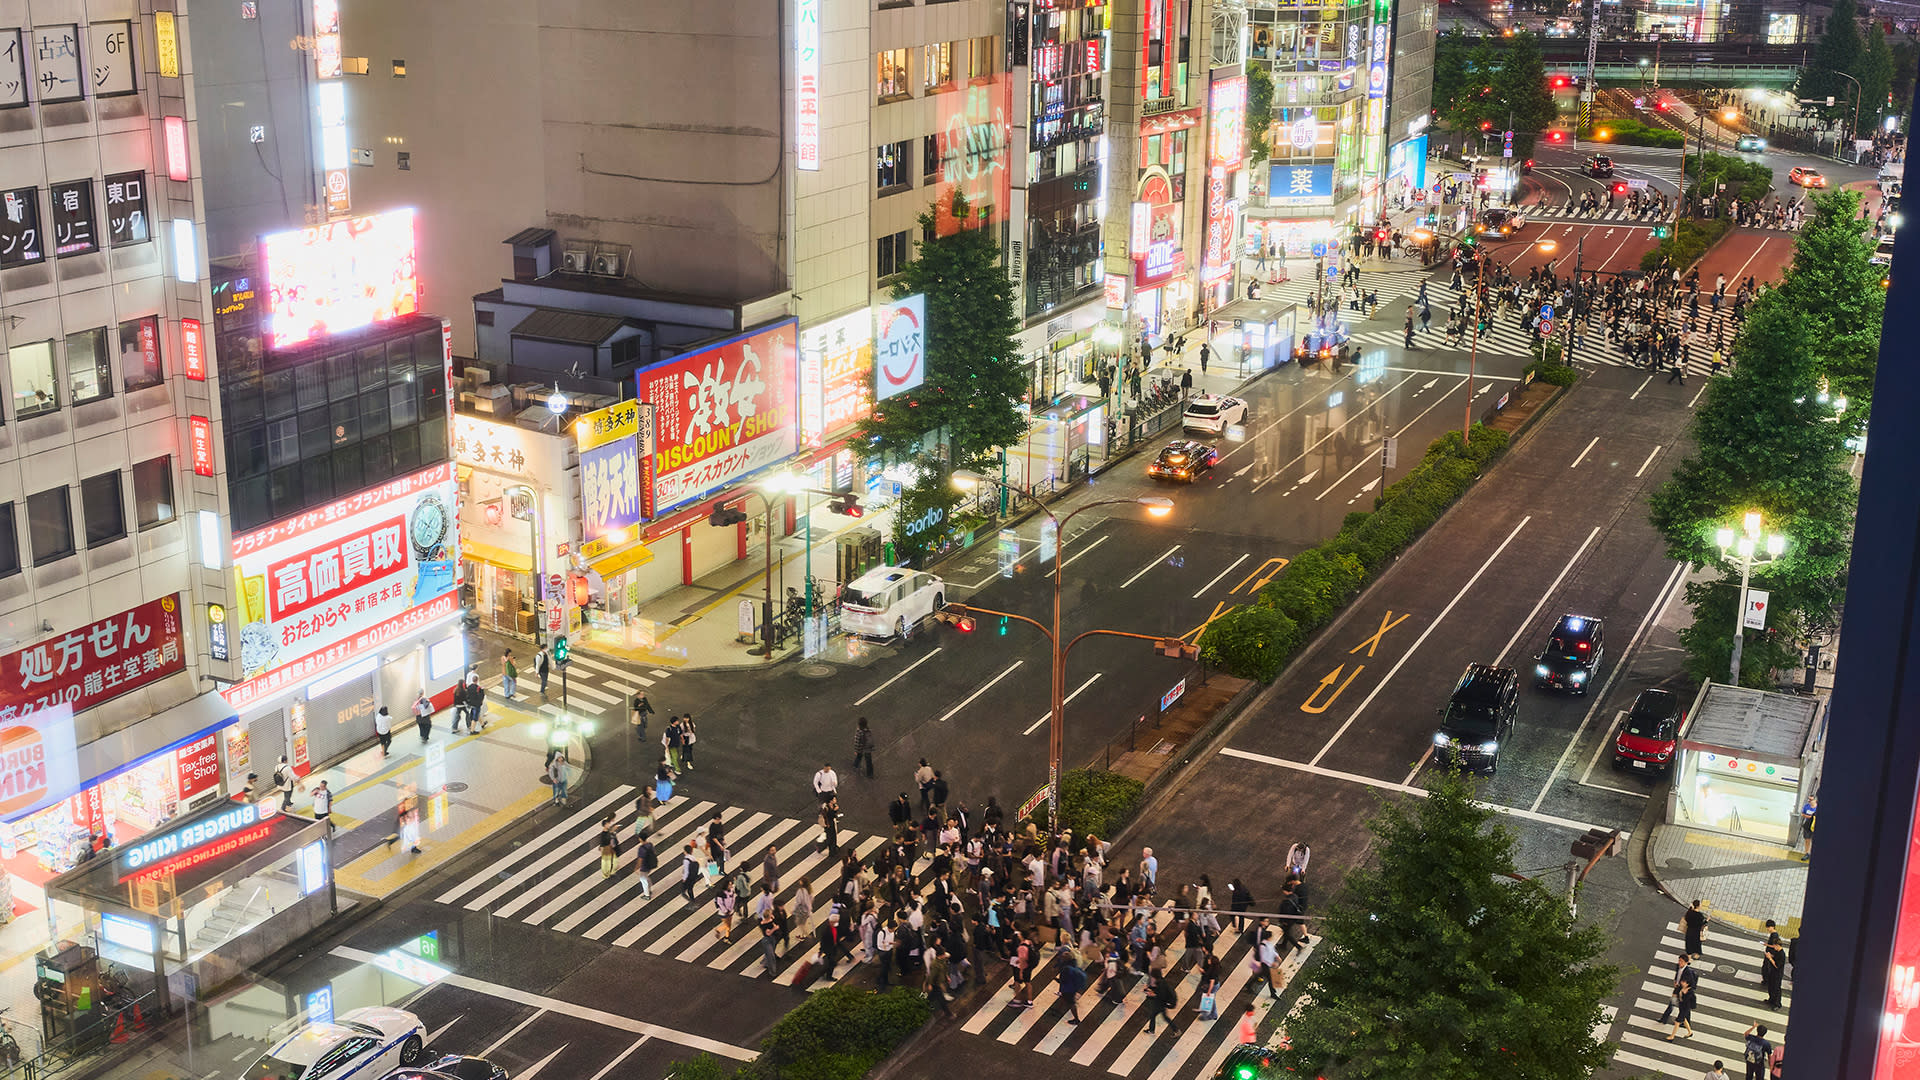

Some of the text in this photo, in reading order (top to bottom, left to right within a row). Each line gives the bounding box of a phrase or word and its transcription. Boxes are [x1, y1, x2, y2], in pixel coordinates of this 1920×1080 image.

[106, 33, 125, 54] 6F
[801, 75, 816, 161] 三平本館
[1289, 169, 1313, 194] 薬
[594, 408, 636, 436] 博多天神
[684, 343, 766, 446] 激安
[657, 405, 789, 475] DISCOUNT SHOP
[583, 447, 637, 531] 博多天神
[274, 523, 402, 613] 高価買取
[281, 582, 402, 647] おたからや 新宿本店
[369, 597, 450, 645] 0120-555-600
[19, 611, 151, 689] 処方せん
[179, 753, 217, 775] Tax-free
[193, 764, 217, 781] Shop
